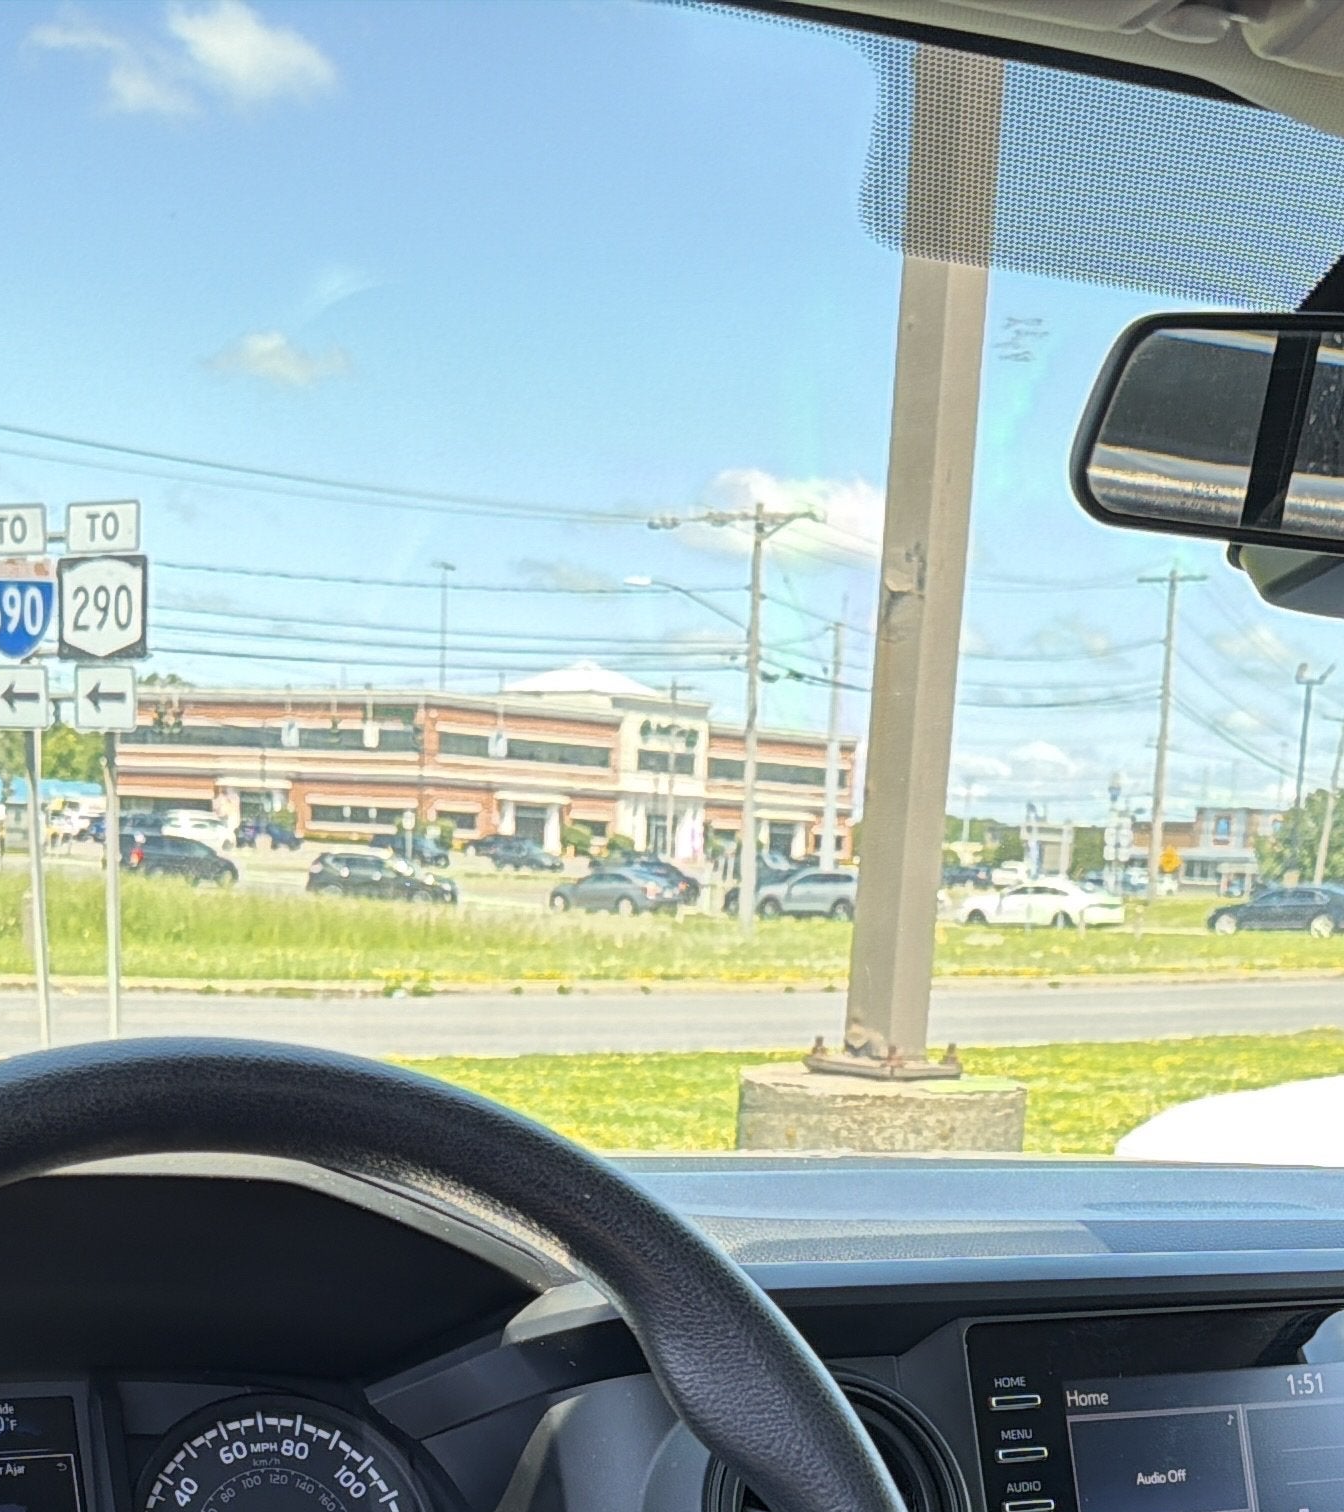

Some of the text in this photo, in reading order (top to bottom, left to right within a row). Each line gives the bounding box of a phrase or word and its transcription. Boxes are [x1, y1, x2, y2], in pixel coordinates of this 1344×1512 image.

[86, 511, 119, 542] TO
[72, 584, 133, 632] 290
[994, 1376, 1026, 1388] HOME
[1286, 1372, 1323, 1395] 1:51
[1066, 1390, 1109, 1407] Home
[1001, 1429, 1033, 1440] MENU
[219, 1440, 308, 1464] 60 MPH 80
[5, 1463, 25, 1476] Ajar
[252, 1457, 280, 1467] km/h
[241, 1475, 261, 1489] 100
[269, 1474, 288, 1485] 120
[334, 1465, 366, 1498] 100
[1136, 1469, 1186, 1485] Audio Off
[174, 1477, 198, 1507] 40
[295, 1478, 315, 1495] 140
[1007, 1480, 1041, 1493] AUDIO
[220, 1488, 236, 1504] 80
[319, 1492, 336, 1512] 160
